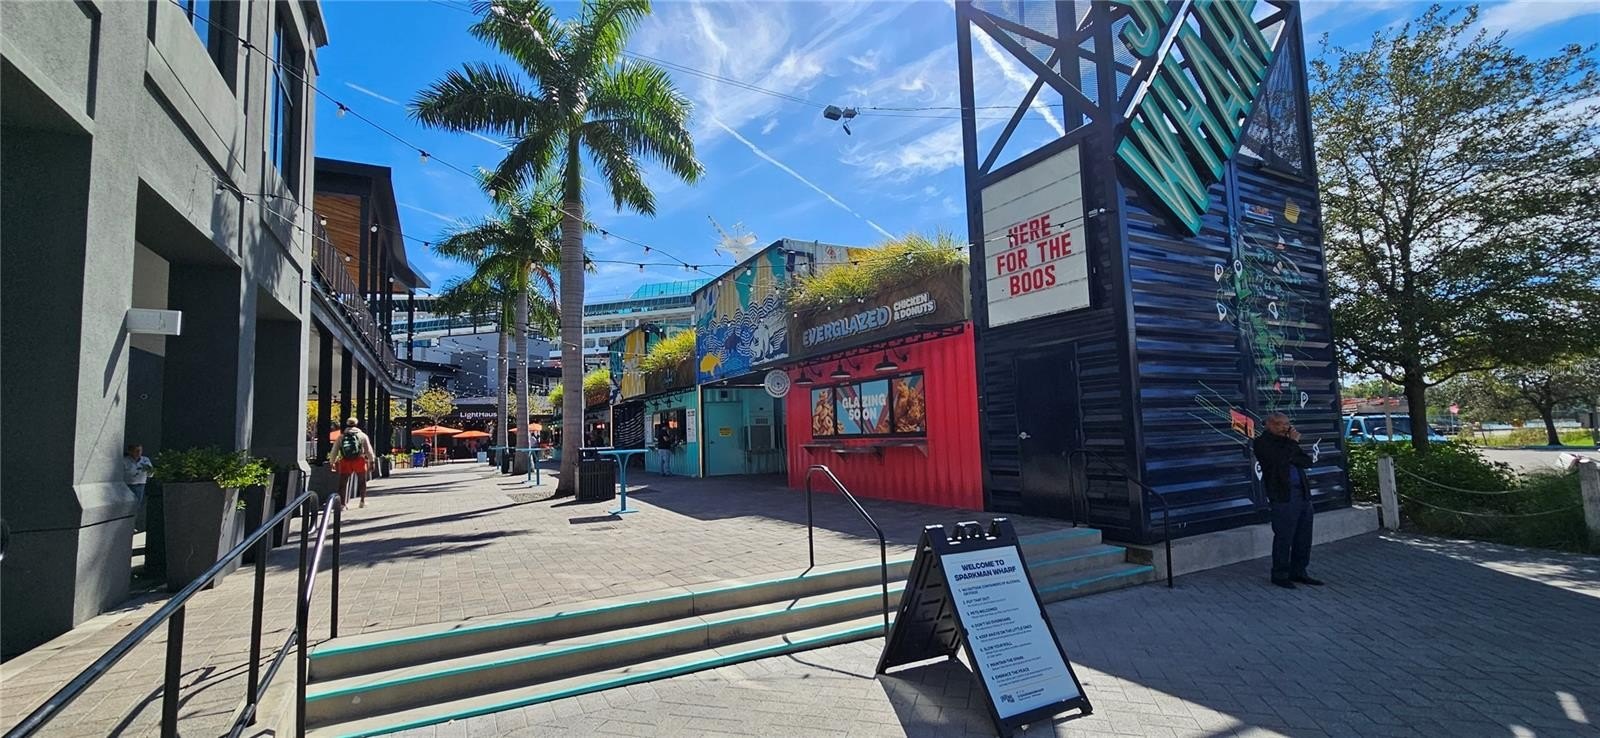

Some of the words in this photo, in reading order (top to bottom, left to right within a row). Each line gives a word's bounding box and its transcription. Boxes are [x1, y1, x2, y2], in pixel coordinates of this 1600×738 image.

[1008, 214, 1051, 248] HERE
[996, 248, 1028, 275] FOR
[1037, 233, 1072, 262] THE
[1009, 265, 1056, 296] BOOS
[894, 293, 928, 311] CHICKEN
[900, 301, 934, 319] DONUTS
[803, 306, 890, 346] EVERGLAZED
[842, 393, 886, 409] GLAZING
[849, 407, 877, 420] SOON
[954, 571, 993, 582] SPARKMAN
[993, 566, 1017, 575] WHARF
[961, 562, 995, 571] WELCOME
